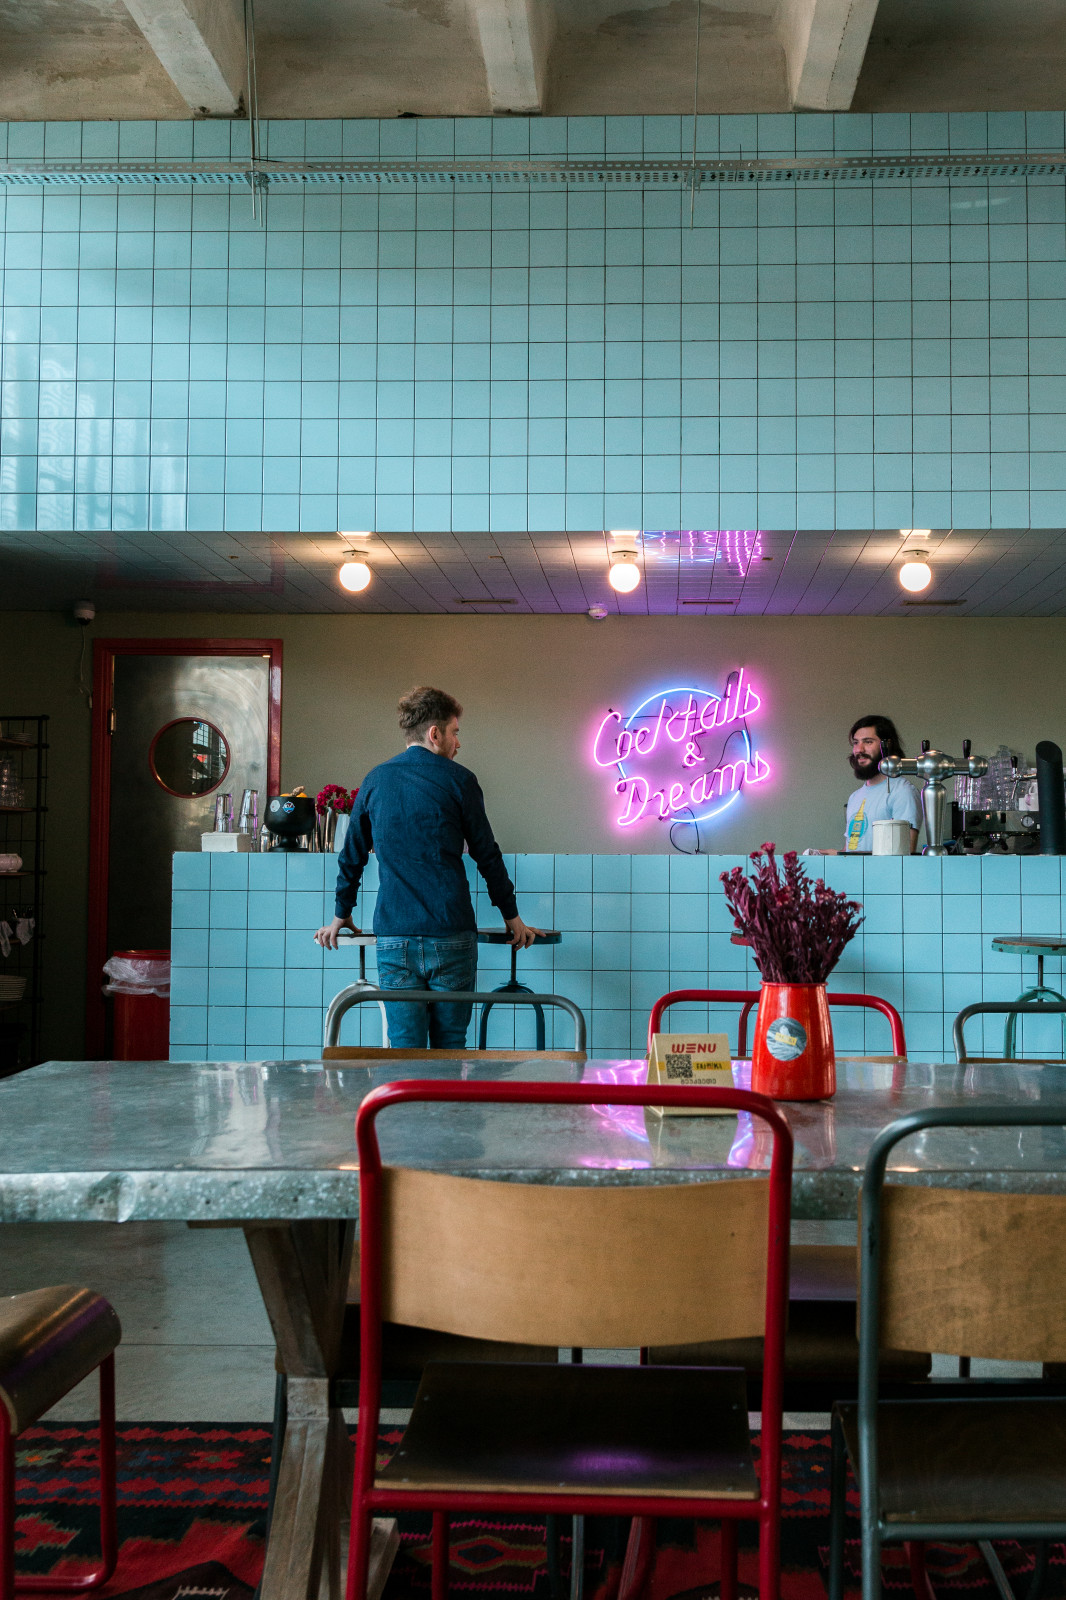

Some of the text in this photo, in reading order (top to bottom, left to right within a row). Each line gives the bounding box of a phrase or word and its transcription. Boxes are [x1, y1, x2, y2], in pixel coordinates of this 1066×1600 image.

[593, 667, 761, 767] Cocktails
[683, 741, 706, 767] &
[614, 751, 771, 826] Dreams
[671, 1043, 717, 1054] WENU
